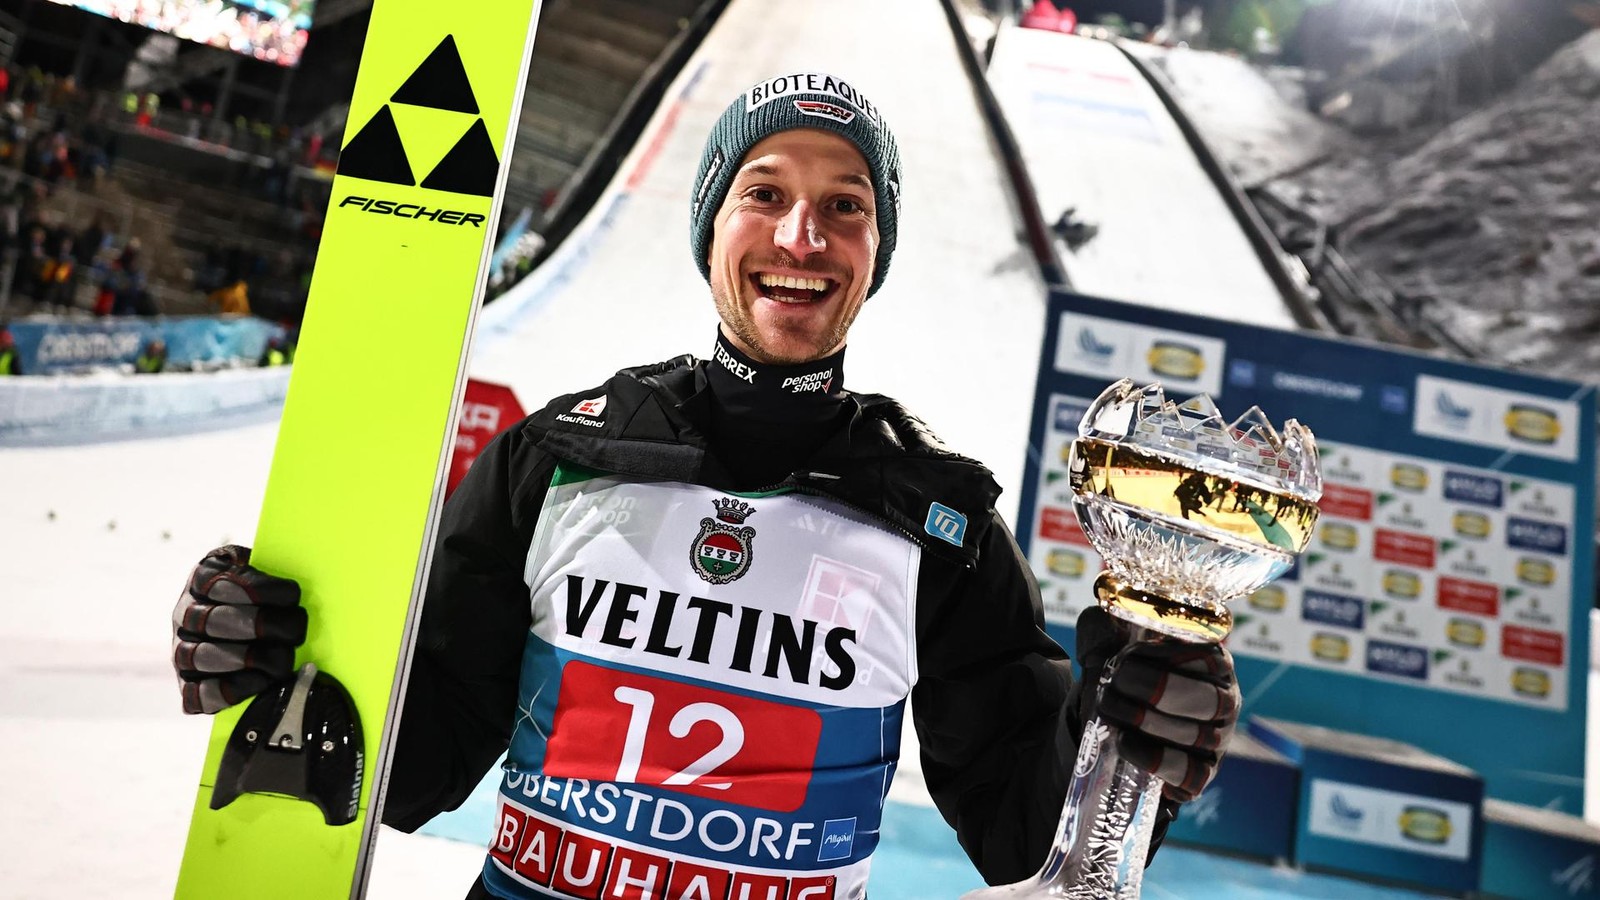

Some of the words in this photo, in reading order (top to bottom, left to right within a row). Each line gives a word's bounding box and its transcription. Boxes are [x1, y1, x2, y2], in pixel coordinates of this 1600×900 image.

[751, 73, 877, 122] BIOTEAQUE
[339, 195, 486, 228] FISCHER
[713, 340, 757, 384] TERREX
[781, 368, 833, 389] personal
[791, 379, 822, 394] shop
[555, 413, 605, 428] Kaufland
[934, 509, 960, 542] TQ
[565, 574, 857, 691] VELTINS
[613, 685, 745, 790] 12
[347, 750, 364, 819] Slatnar
[502, 764, 815, 861] OBERSTDORF
